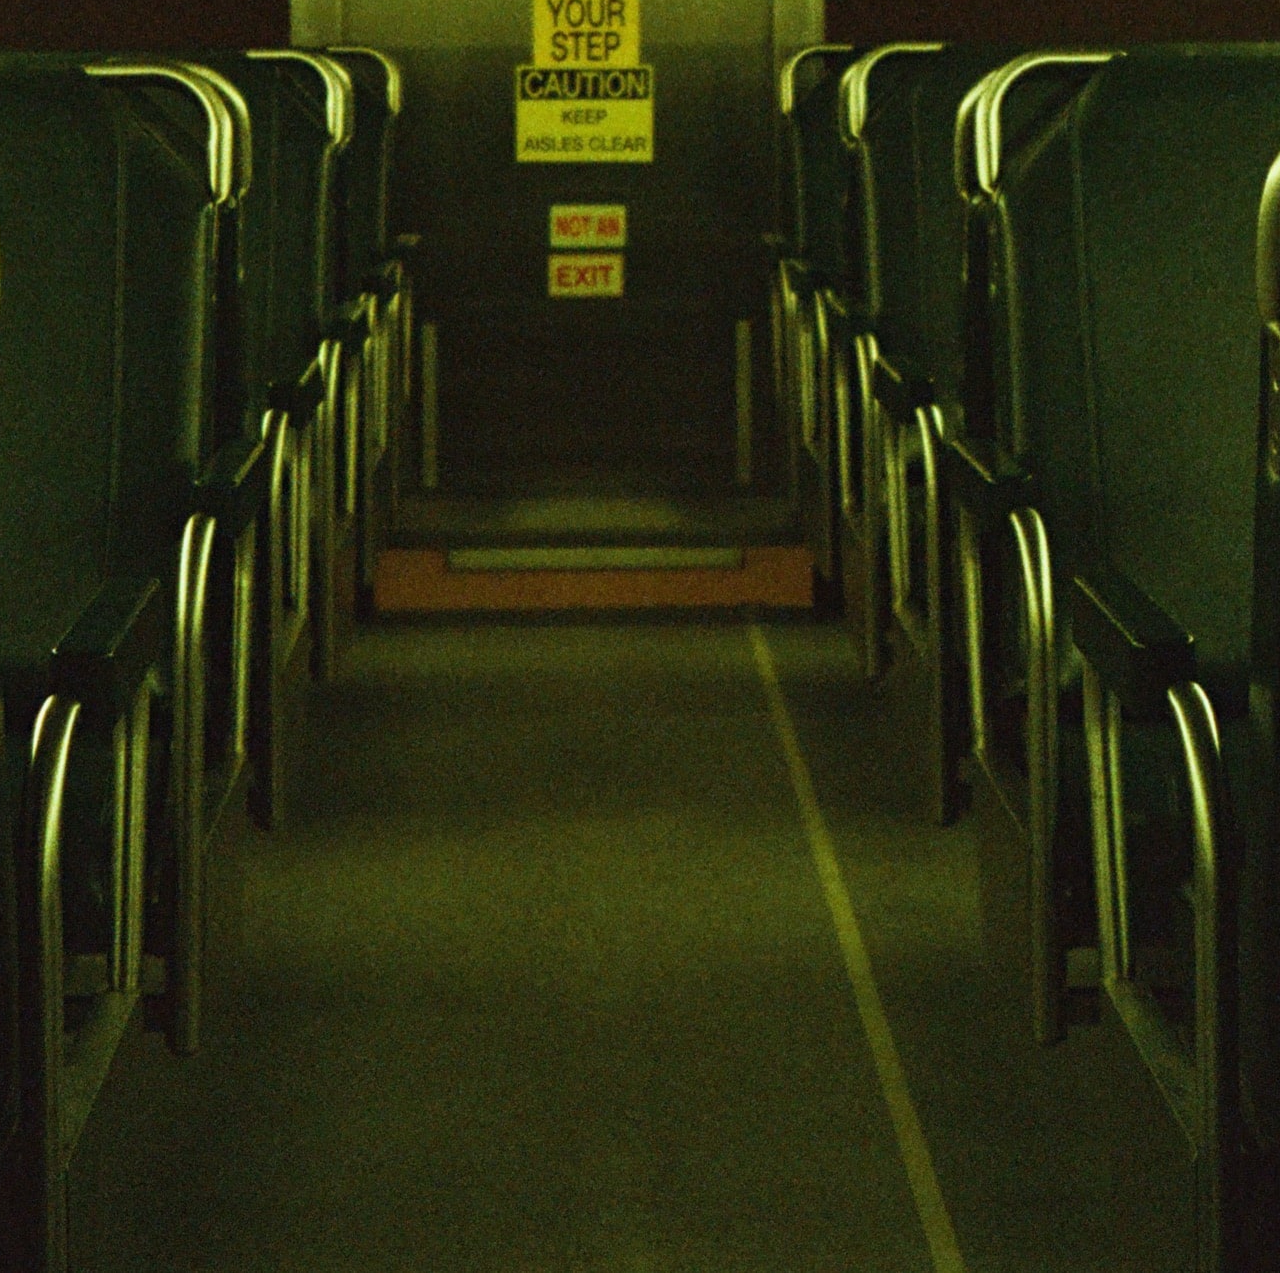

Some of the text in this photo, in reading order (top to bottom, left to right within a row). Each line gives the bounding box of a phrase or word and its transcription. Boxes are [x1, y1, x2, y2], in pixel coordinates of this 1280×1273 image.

[551, 31, 620, 61] STEP
[524, 72, 645, 98] CAUTION
[561, 109, 607, 125] KEEP
[524, 136, 646, 152] AISLES CLEAR
[556, 216, 590, 237] NOT
[556, 265, 613, 287] EXIT
